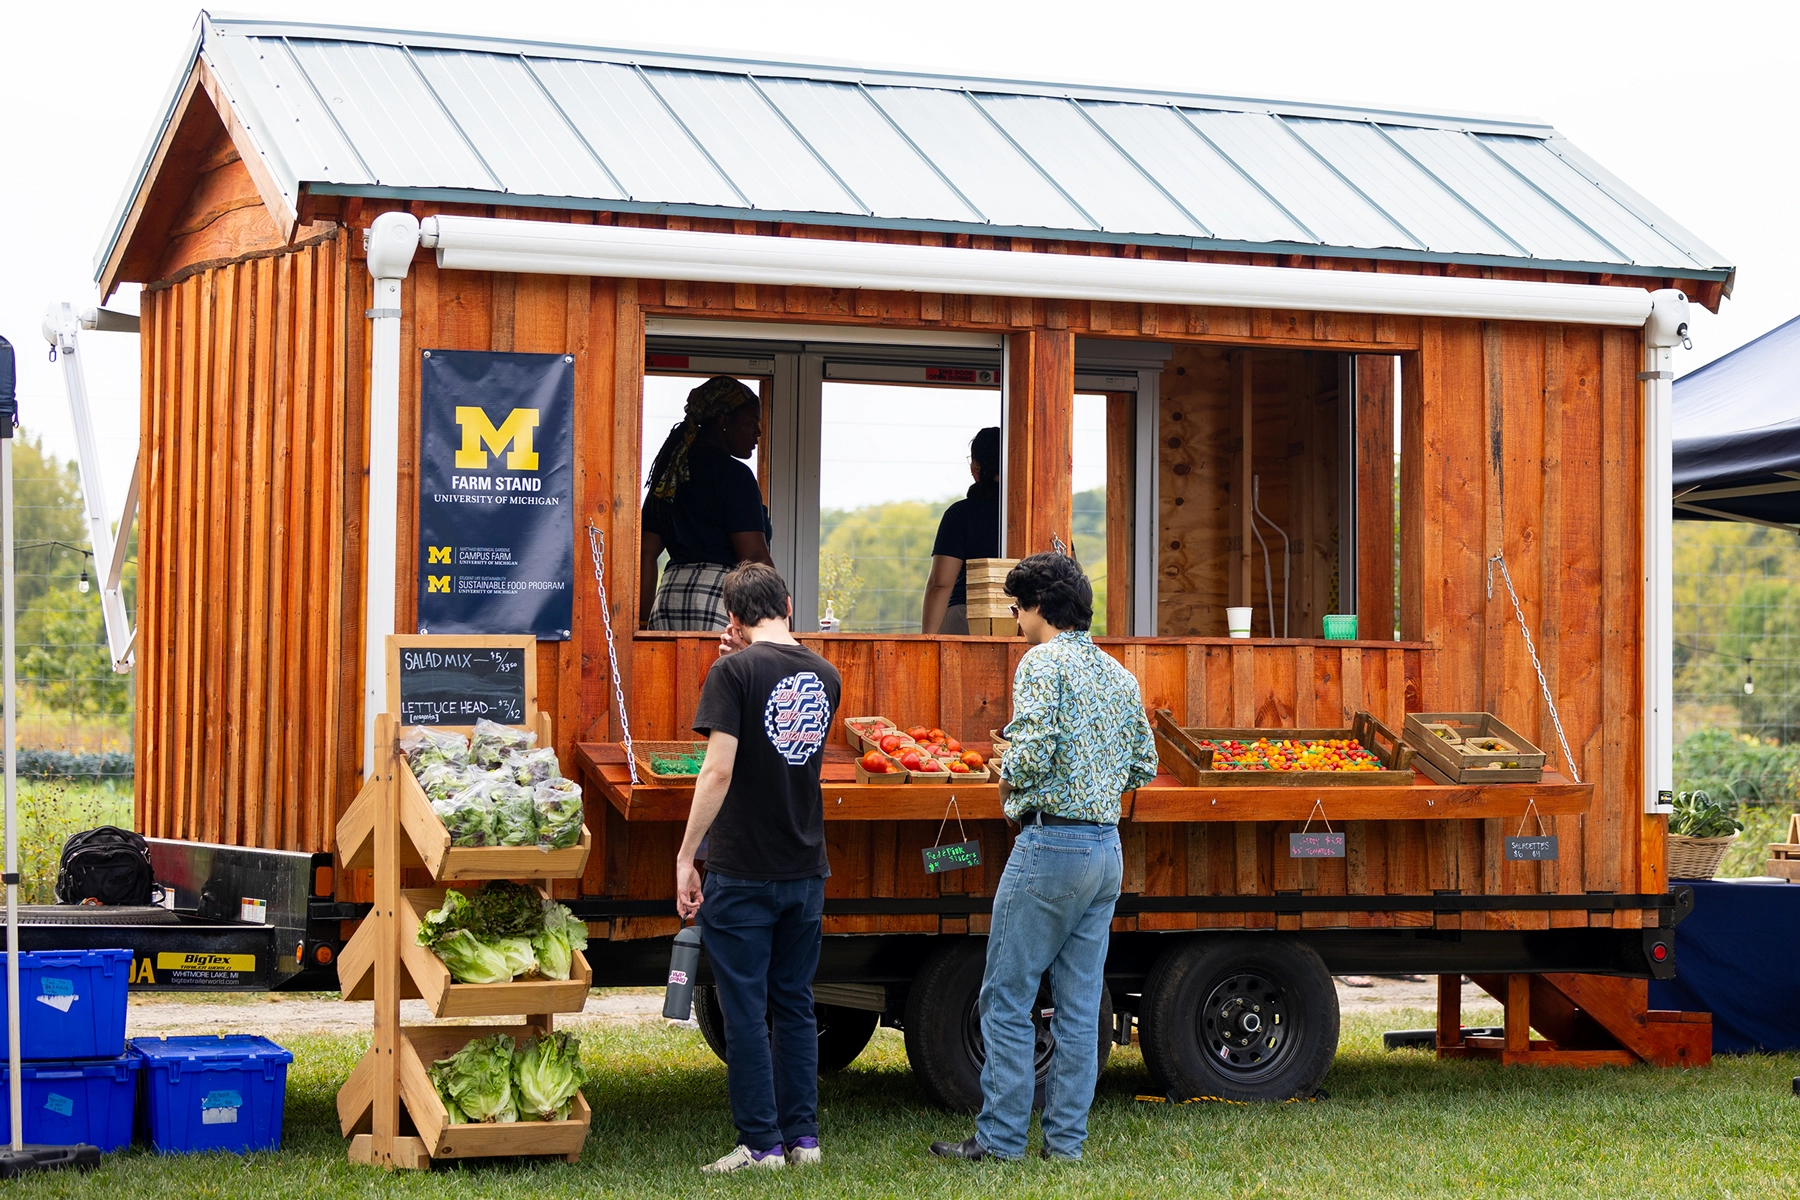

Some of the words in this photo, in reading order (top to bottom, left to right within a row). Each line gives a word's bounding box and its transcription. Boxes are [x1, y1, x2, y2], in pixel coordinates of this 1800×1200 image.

[455, 406, 540, 470] M
[452, 476, 491, 491] FARM
[496, 477, 541, 491] STAND
[434, 494, 493, 504] UNIVERSITY
[495, 495, 508, 504] OF
[510, 496, 559, 505] MICHIGAN
[428, 546, 452, 564] M
[459, 552, 490, 560] CAMPUS
[492, 552, 511, 560] FARM
[428, 575, 451, 593] M
[458, 581, 506, 589] SUSTAINABLE
[508, 581, 526, 590] FOOD
[528, 582, 565, 590] PROGRAM
[404, 652, 442, 670] SALAD
[444, 653, 472, 668] MIX
[402, 701, 457, 714] LETTUCE
[460, 701, 488, 714] HEAD
[926, 850, 941, 860] Red
[946, 846, 965, 856] Pink
[184, 955, 231, 965] BigTex
